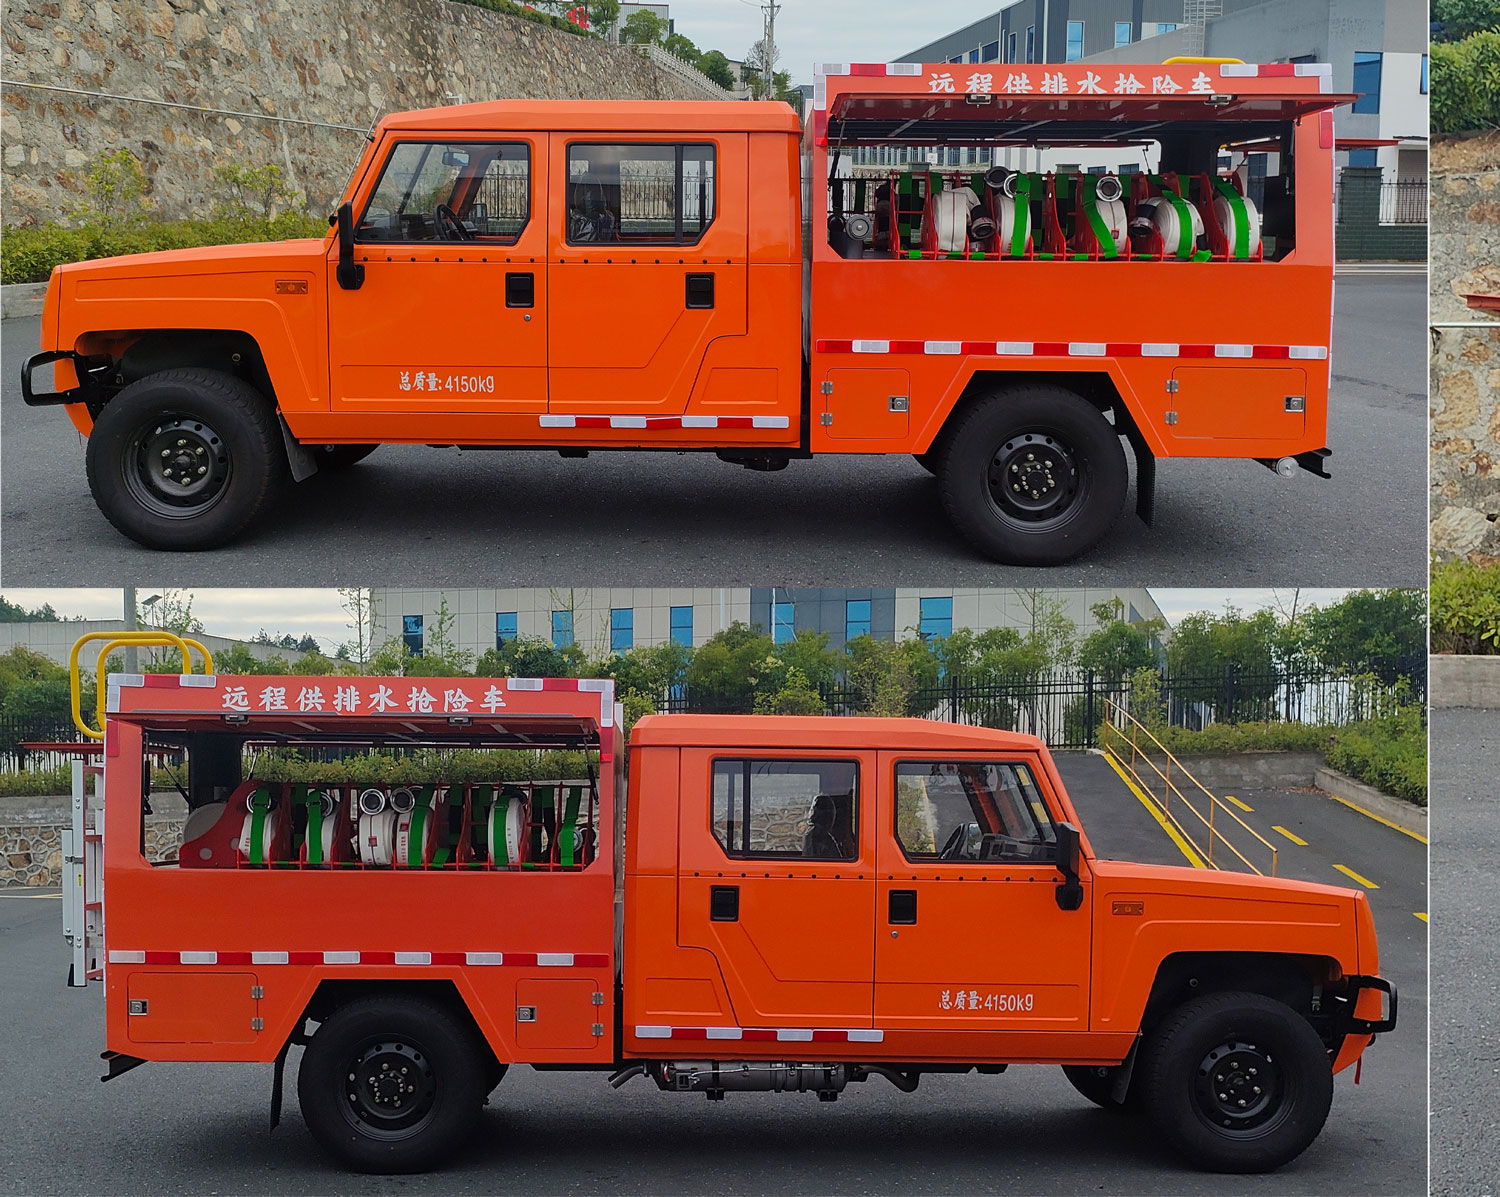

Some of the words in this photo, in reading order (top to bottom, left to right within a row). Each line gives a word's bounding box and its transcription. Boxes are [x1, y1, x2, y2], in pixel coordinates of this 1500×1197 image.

[928, 71, 1216, 94] 远程供排水抢险车
[399, 371, 495, 393] 总质量:4150kg
[221, 684, 507, 714] 远程供排水抢险车
[939, 989, 1034, 1012] 总质量:4150kg
